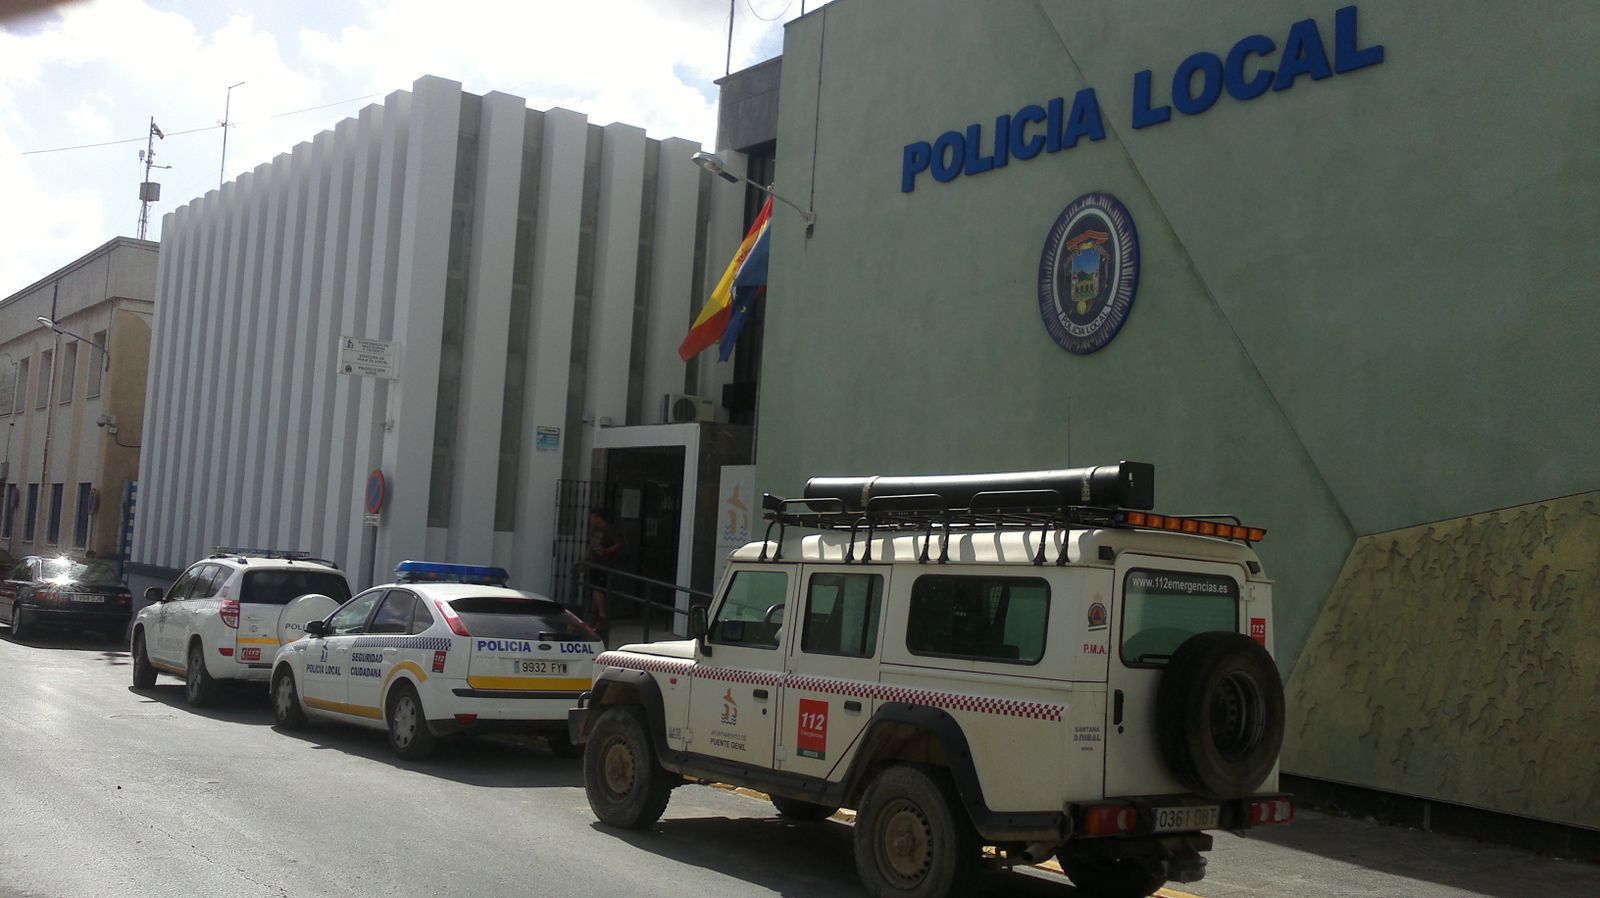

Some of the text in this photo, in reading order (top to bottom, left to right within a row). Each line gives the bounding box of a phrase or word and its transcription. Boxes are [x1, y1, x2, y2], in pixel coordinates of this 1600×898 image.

[902, 5, 1384, 193] POLICIA LOCAL
[1061, 311, 1109, 335] POLICIA LOCAL
[1132, 577, 1229, 595] www.112emergencias.es
[285, 622, 306, 631] POLI
[1252, 624, 1265, 634] 112
[477, 639, 594, 654] POLICIA LOCAL
[1083, 644, 1107, 655] P.M.A.
[351, 652, 384, 664] SEGURIDAD
[306, 663, 342, 676] POLICIA LOCAL
[350, 666, 382, 679] CIUDADANA
[522, 662, 546, 673] 9932
[801, 712, 825, 731] 112
[710, 737, 730, 749] PUENTE
[1159, 809, 1190, 828] 0361
